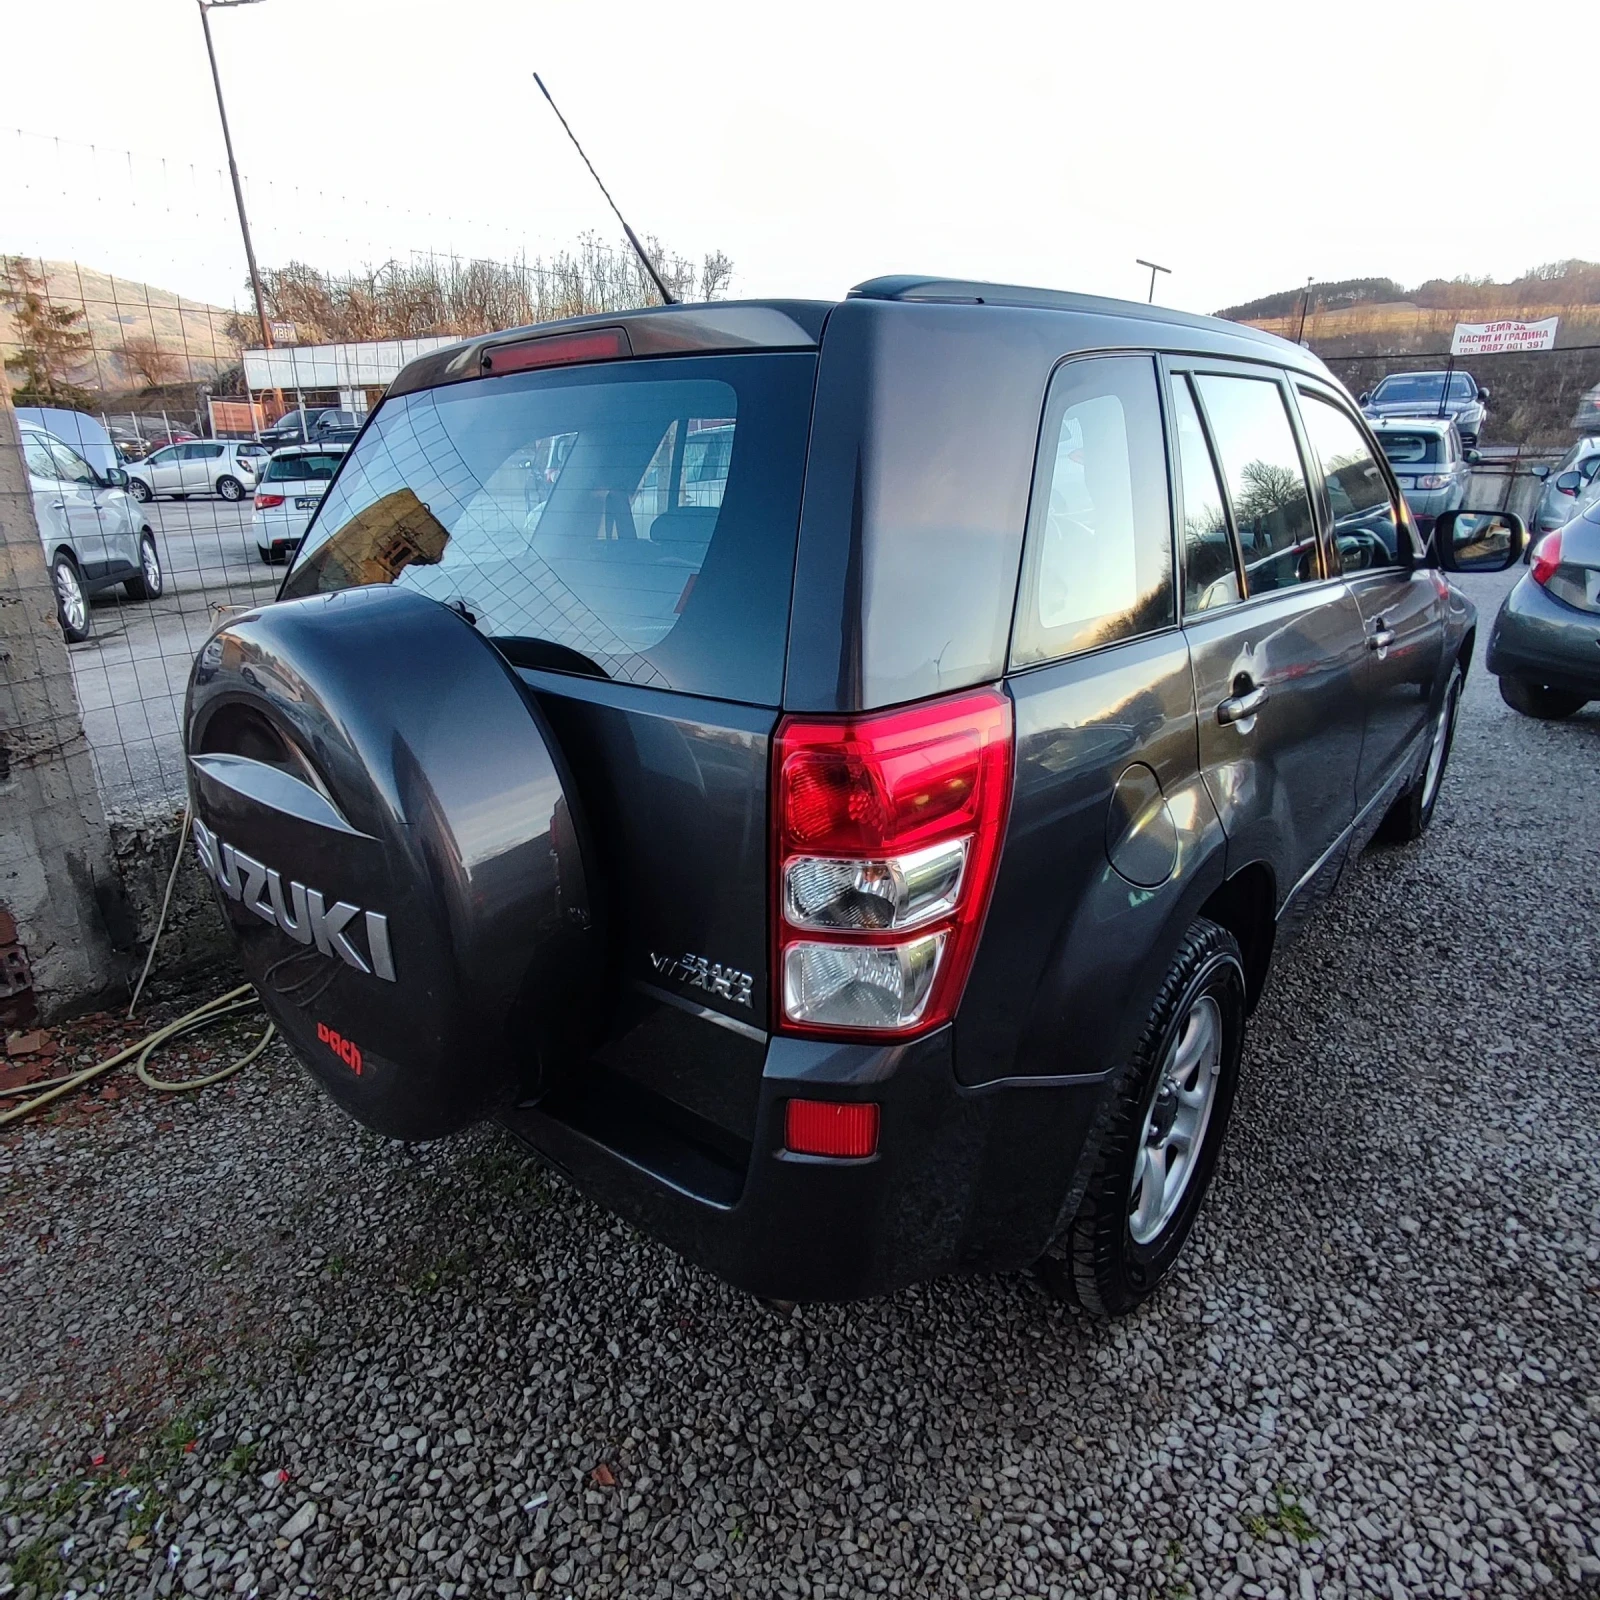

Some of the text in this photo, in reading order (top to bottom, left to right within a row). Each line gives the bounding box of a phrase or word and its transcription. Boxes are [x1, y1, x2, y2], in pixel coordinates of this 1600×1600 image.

[1484, 323, 1511, 333] ЗЕМЯ
[1459, 330, 1549, 343] НАСИП И ГРАДИНА
[1480, 343, 1504, 352] 0887
[1527, 340, 1544, 349] 391
[193, 818, 397, 982] SUZUKI
[650, 952, 753, 1009] VITARA
